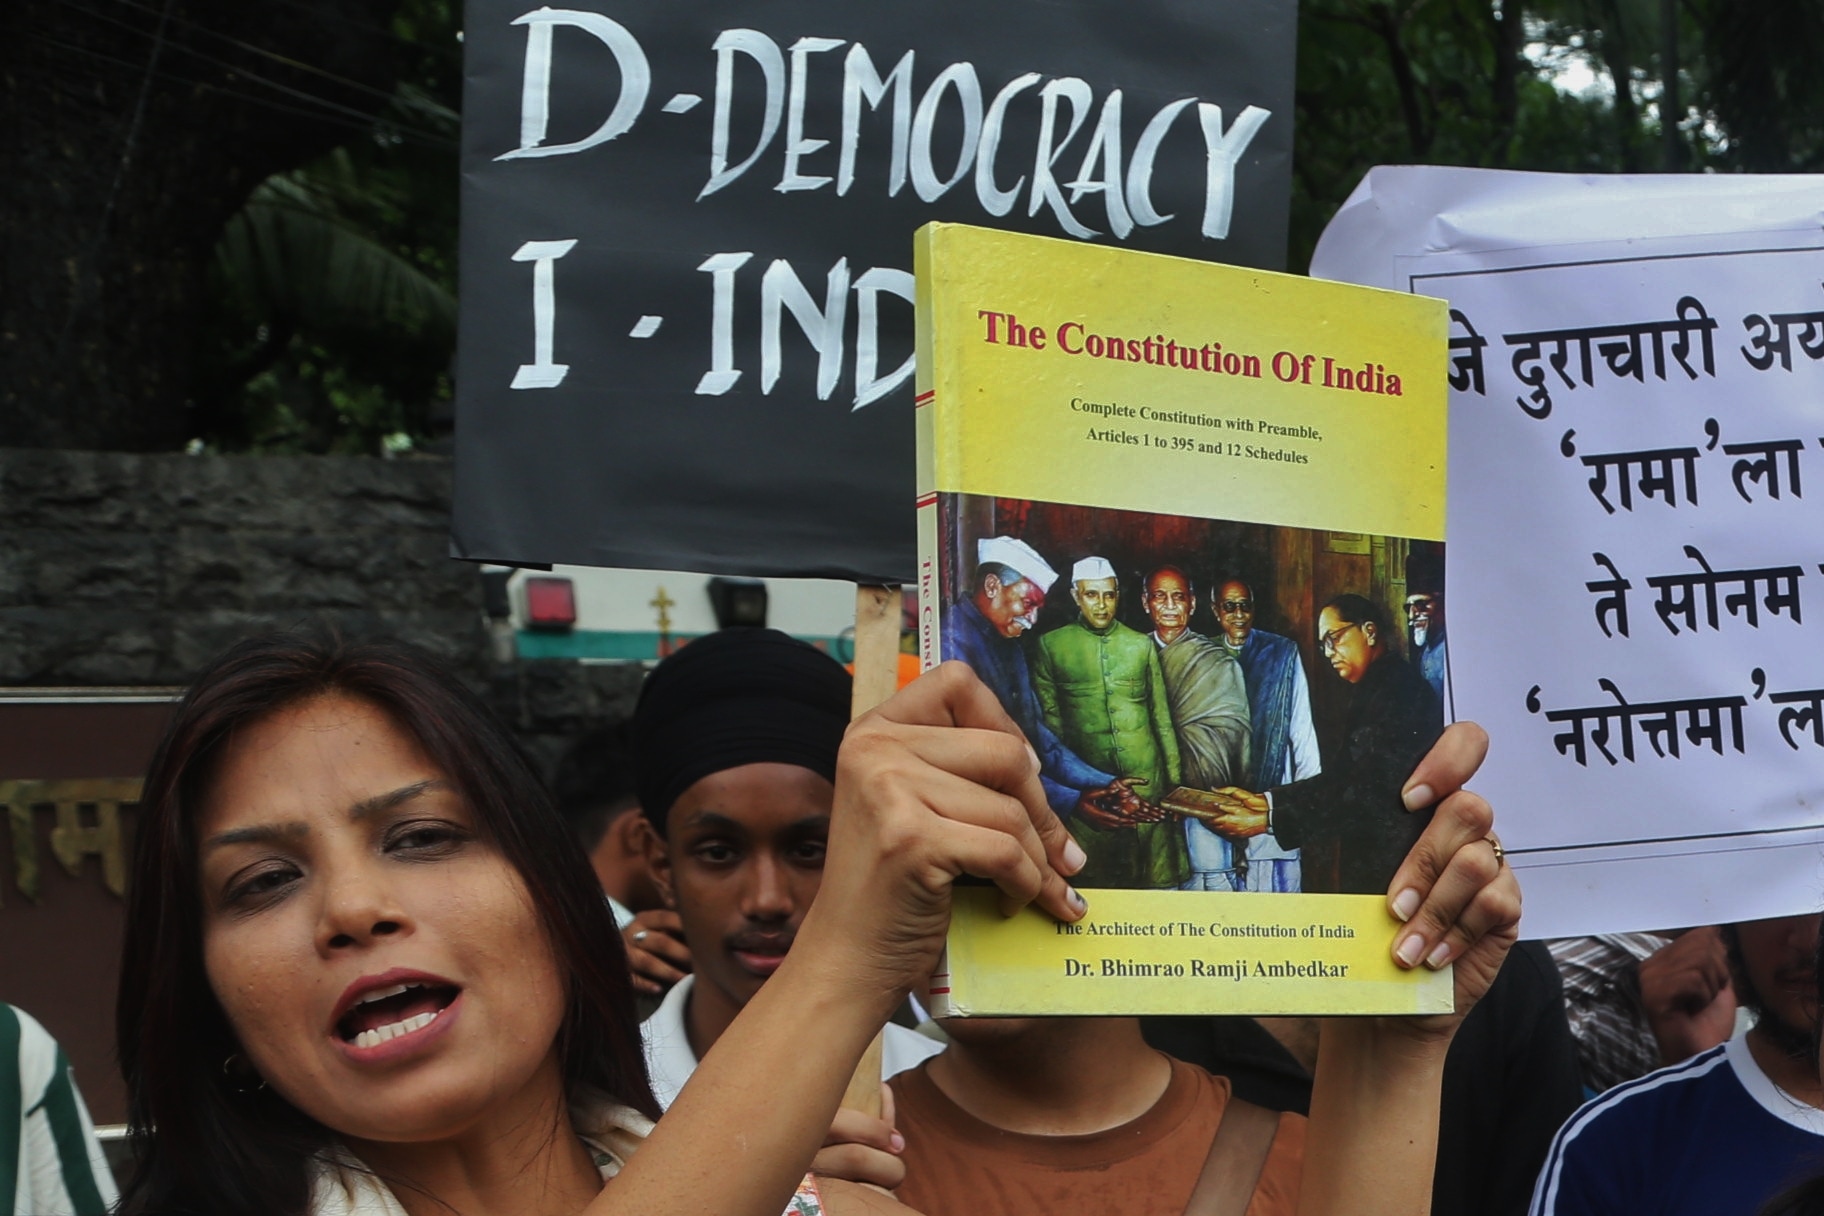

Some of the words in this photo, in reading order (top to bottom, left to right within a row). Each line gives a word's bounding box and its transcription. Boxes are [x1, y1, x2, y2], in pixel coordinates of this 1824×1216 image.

[978, 310, 1046, 350] The
[1057, 321, 1262, 379] Constitution
[1272, 350, 1316, 385] Of
[1321, 356, 1403, 397] India
[1502, 295, 1719, 419] दुराचारी
[1070, 398, 1136, 418] Complete
[1139, 406, 1222, 428] Constitution
[1226, 417, 1254, 432] with
[1258, 421, 1323, 442] Preamble,
[1086, 427, 1139, 445] Articles
[1143, 434, 1150, 446] 1
[1154, 437, 1167, 448] to
[1171, 437, 1194, 451] 395
[1198, 442, 1222, 455] and
[1227, 443, 1241, 457] 12
[1245, 446, 1309, 465] Schedules
[1585, 552, 1632, 639] ते
[1646, 545, 1805, 636] सोनम
[1053, 920, 1082, 936] The
[1087, 922, 1154, 937] Architect
[1159, 922, 1174, 936] of
[1179, 923, 1205, 937] The
[1209, 923, 1297, 938] Constitution
[1301, 925, 1315, 938] of
[1318, 925, 1355, 939] India
[1064, 959, 1094, 977] Dr.
[1101, 959, 1184, 977] Bhimrao
[1190, 959, 1248, 982] Ramji
[1252, 960, 1348, 978] Ambedkar
